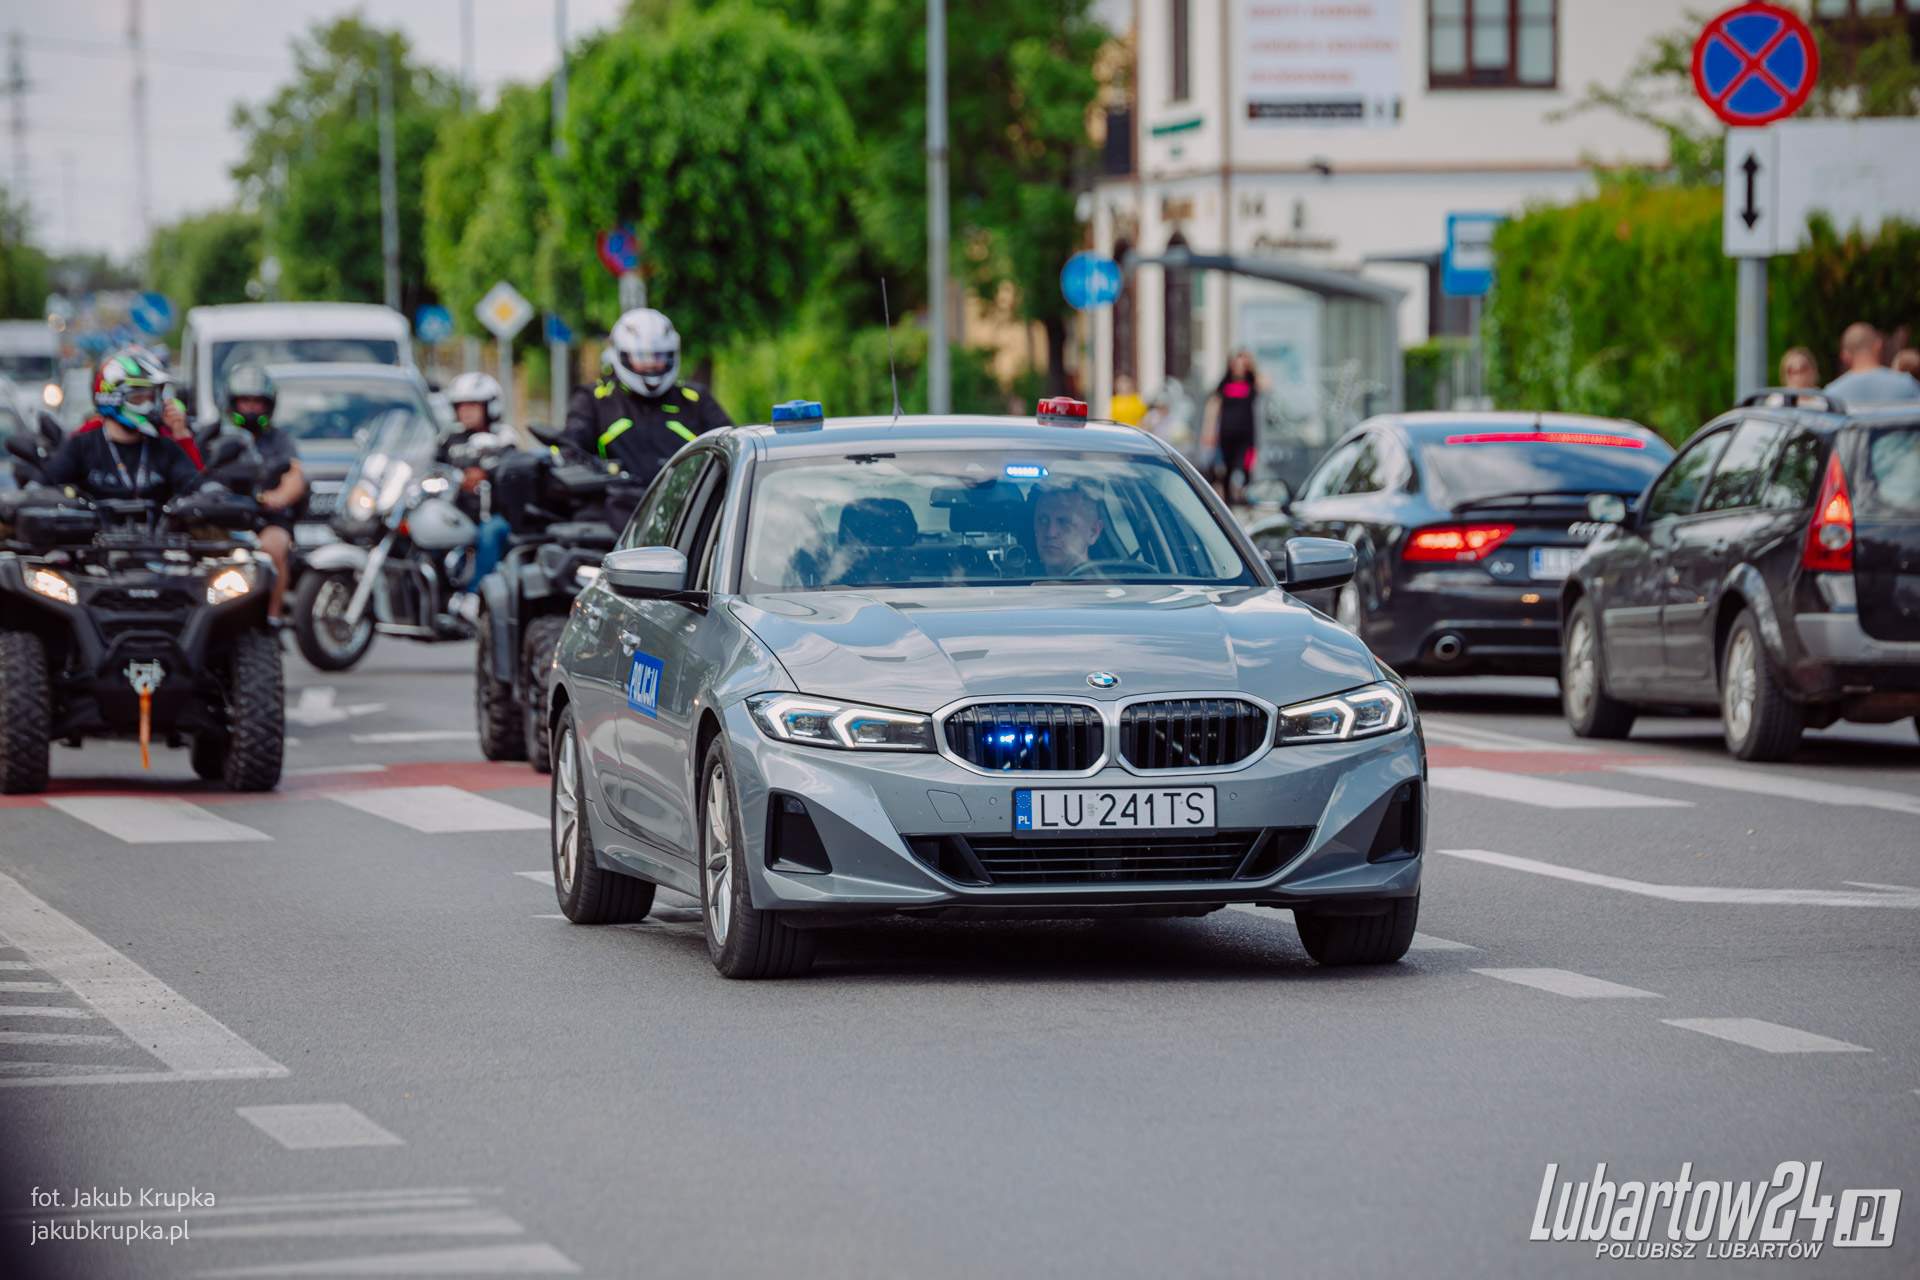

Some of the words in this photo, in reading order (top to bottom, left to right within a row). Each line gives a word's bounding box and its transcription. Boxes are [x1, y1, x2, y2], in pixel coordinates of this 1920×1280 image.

[628, 660, 659, 709] POLICJA
[1018, 815, 1030, 825] PL
[1041, 794, 1083, 827] LU
[1099, 792, 1205, 826] 241TS
